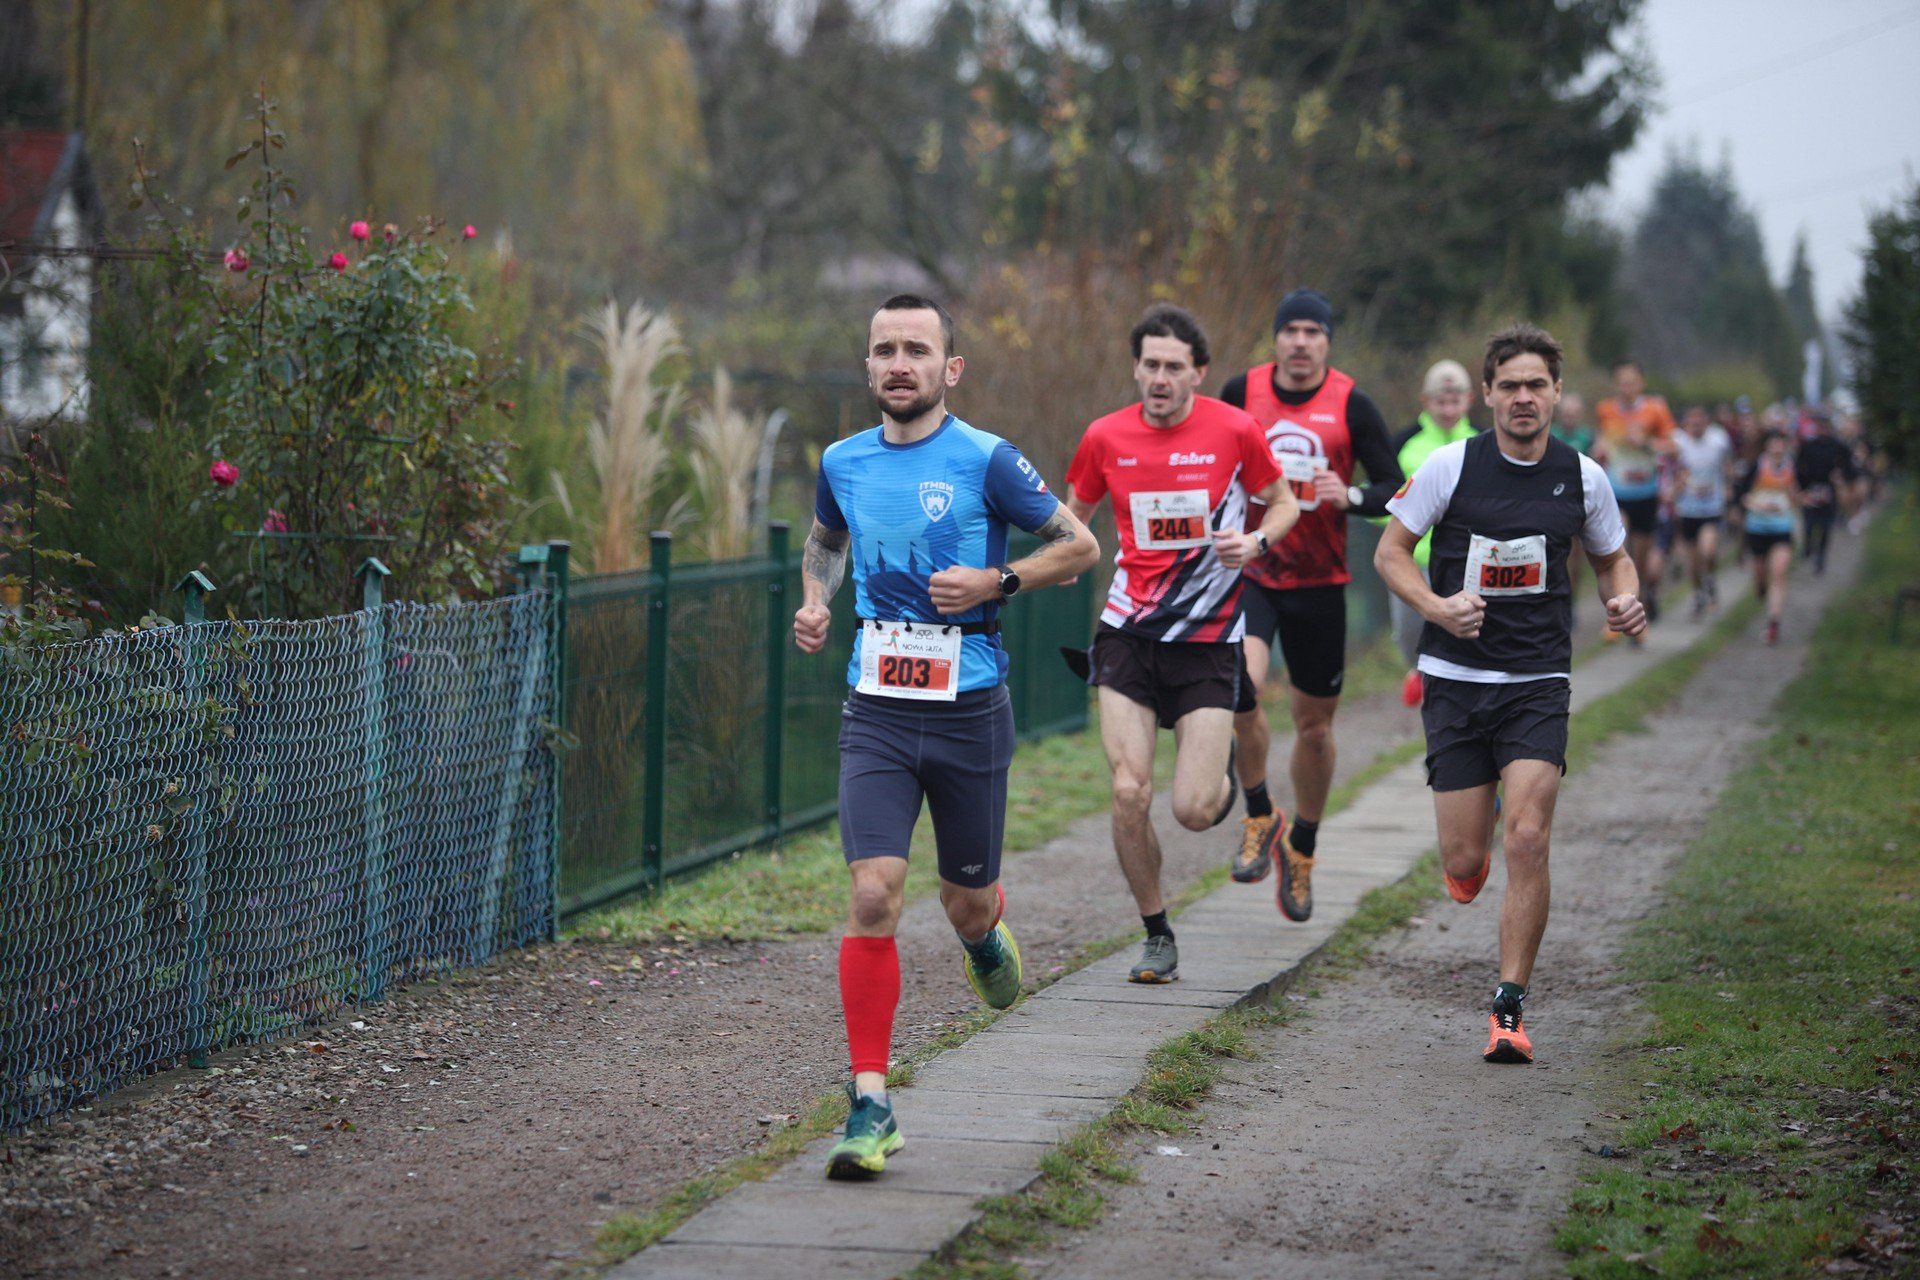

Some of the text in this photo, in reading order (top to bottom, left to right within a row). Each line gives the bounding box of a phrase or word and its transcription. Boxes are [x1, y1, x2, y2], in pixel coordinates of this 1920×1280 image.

[1168, 452, 1216, 466] Sabre
[1152, 517, 1191, 541] 244
[1485, 566, 1526, 588] 302
[902, 643, 924, 652] NOWA
[883, 656, 930, 688] 203
[960, 863, 984, 875] 4F
